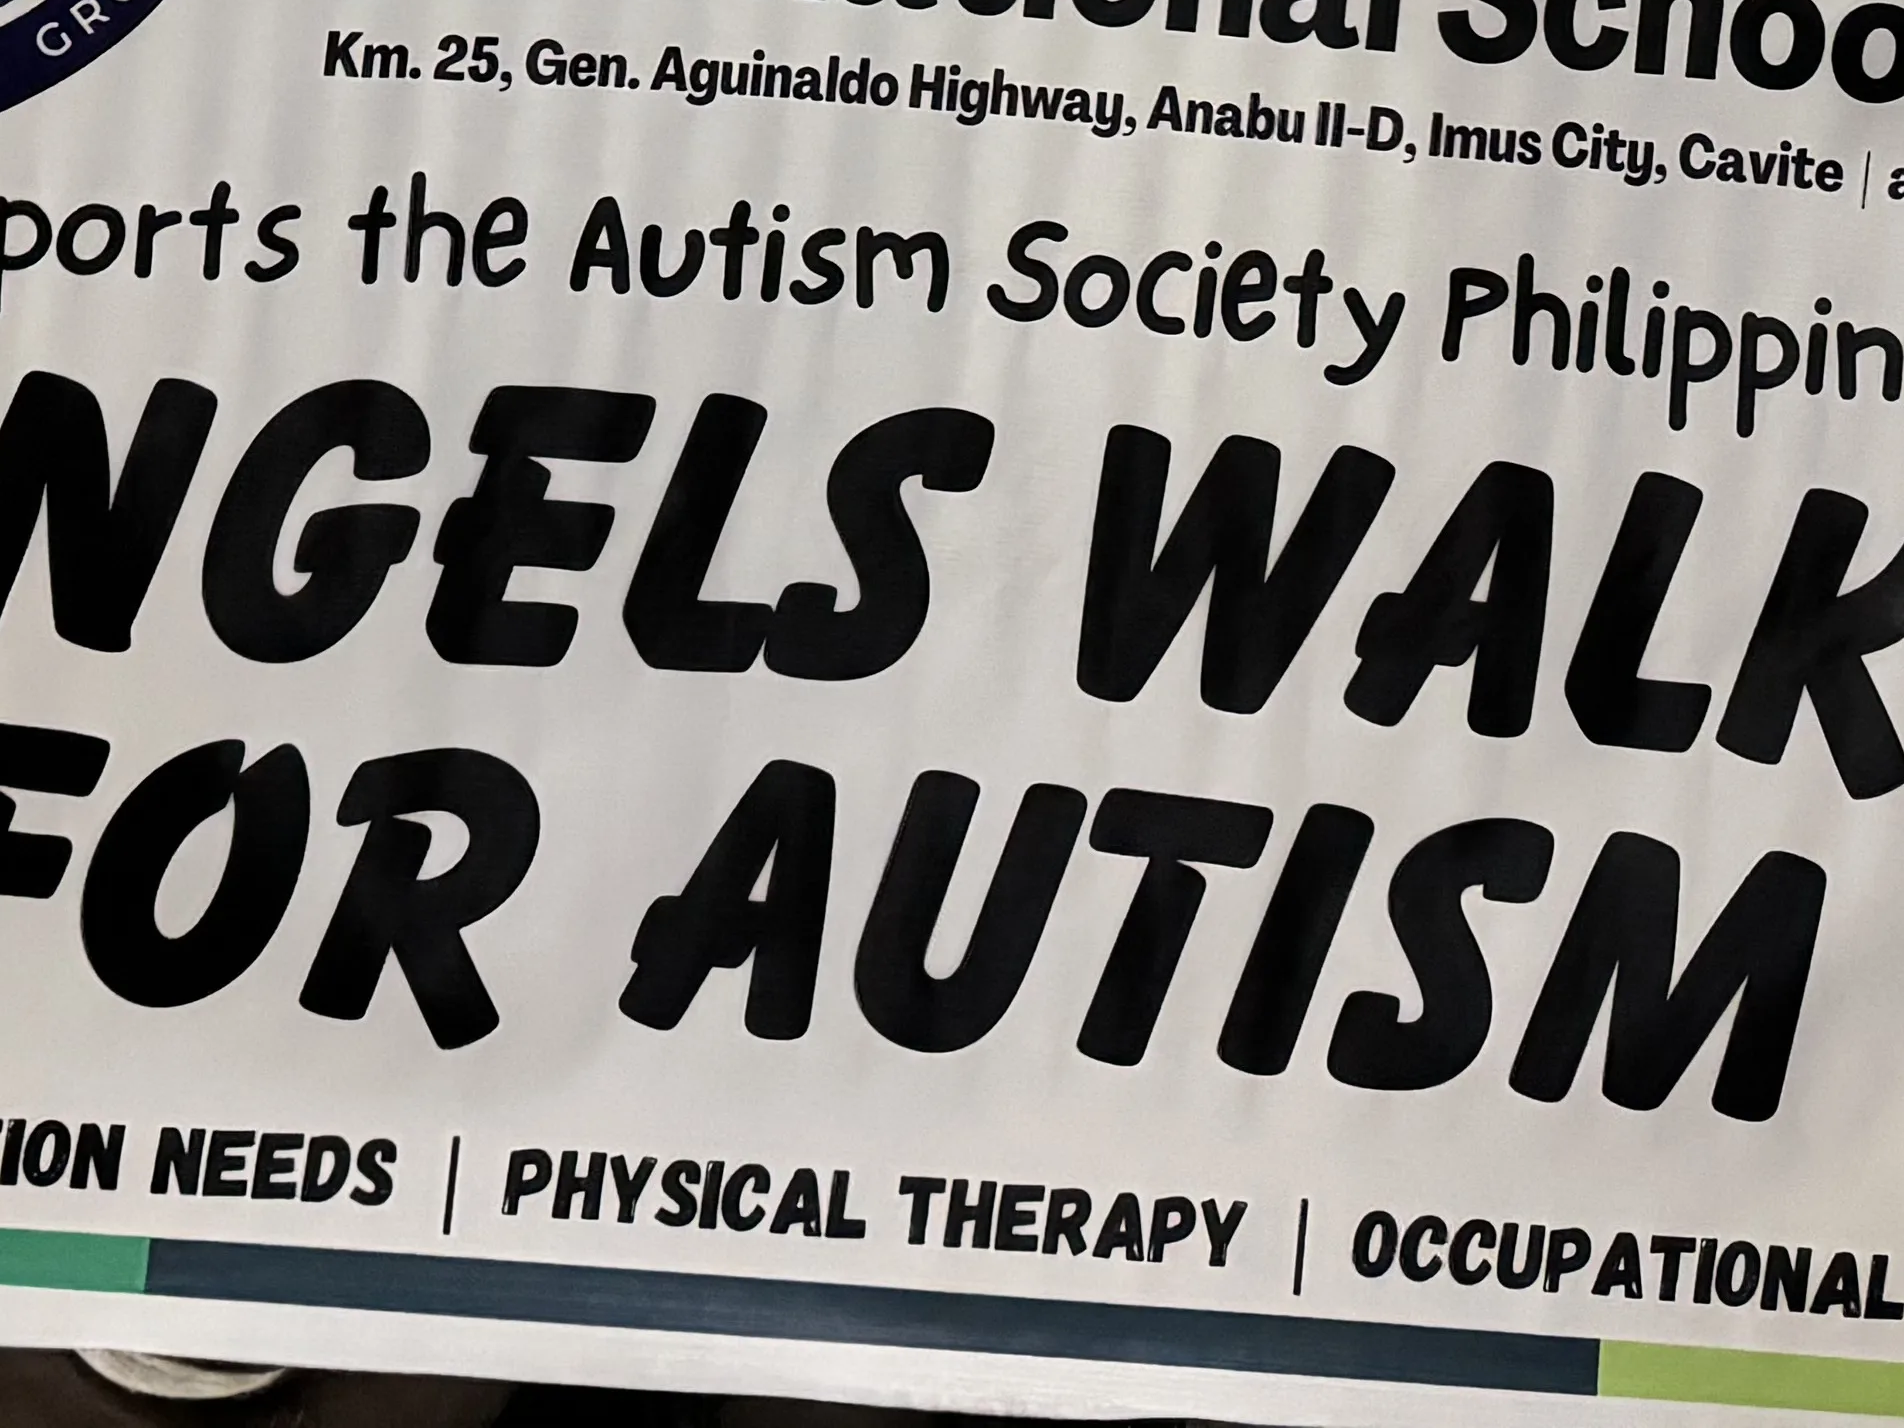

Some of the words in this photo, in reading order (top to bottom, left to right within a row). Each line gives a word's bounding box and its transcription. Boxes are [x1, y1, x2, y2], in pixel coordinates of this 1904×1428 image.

[324, 31, 421, 79] Km.
[434, 35, 512, 91] 25,
[526, 39, 639, 89] Gen.
[651, 47, 898, 106] Aguinaldo
[909, 64, 1136, 137] Highway,
[1147, 86, 1305, 143] Anabu
[1315, 102, 1416, 163] II-D,
[1429, 112, 1541, 165] Imus
[1552, 122, 1666, 186] City,
[1679, 137, 1844, 193] Cavite
[348, 172, 528, 287] the
[570, 197, 949, 312] Autism
[987, 221, 1405, 385] Society
[619, 760, 1826, 1122] AUTISM
[151, 1127, 396, 1205] NEEDS
[502, 1149, 866, 1238] PHYSICAL
[899, 1176, 1247, 1267] THERAPY
[1352, 1211, 1904, 1320] OCCUPATIONAL
